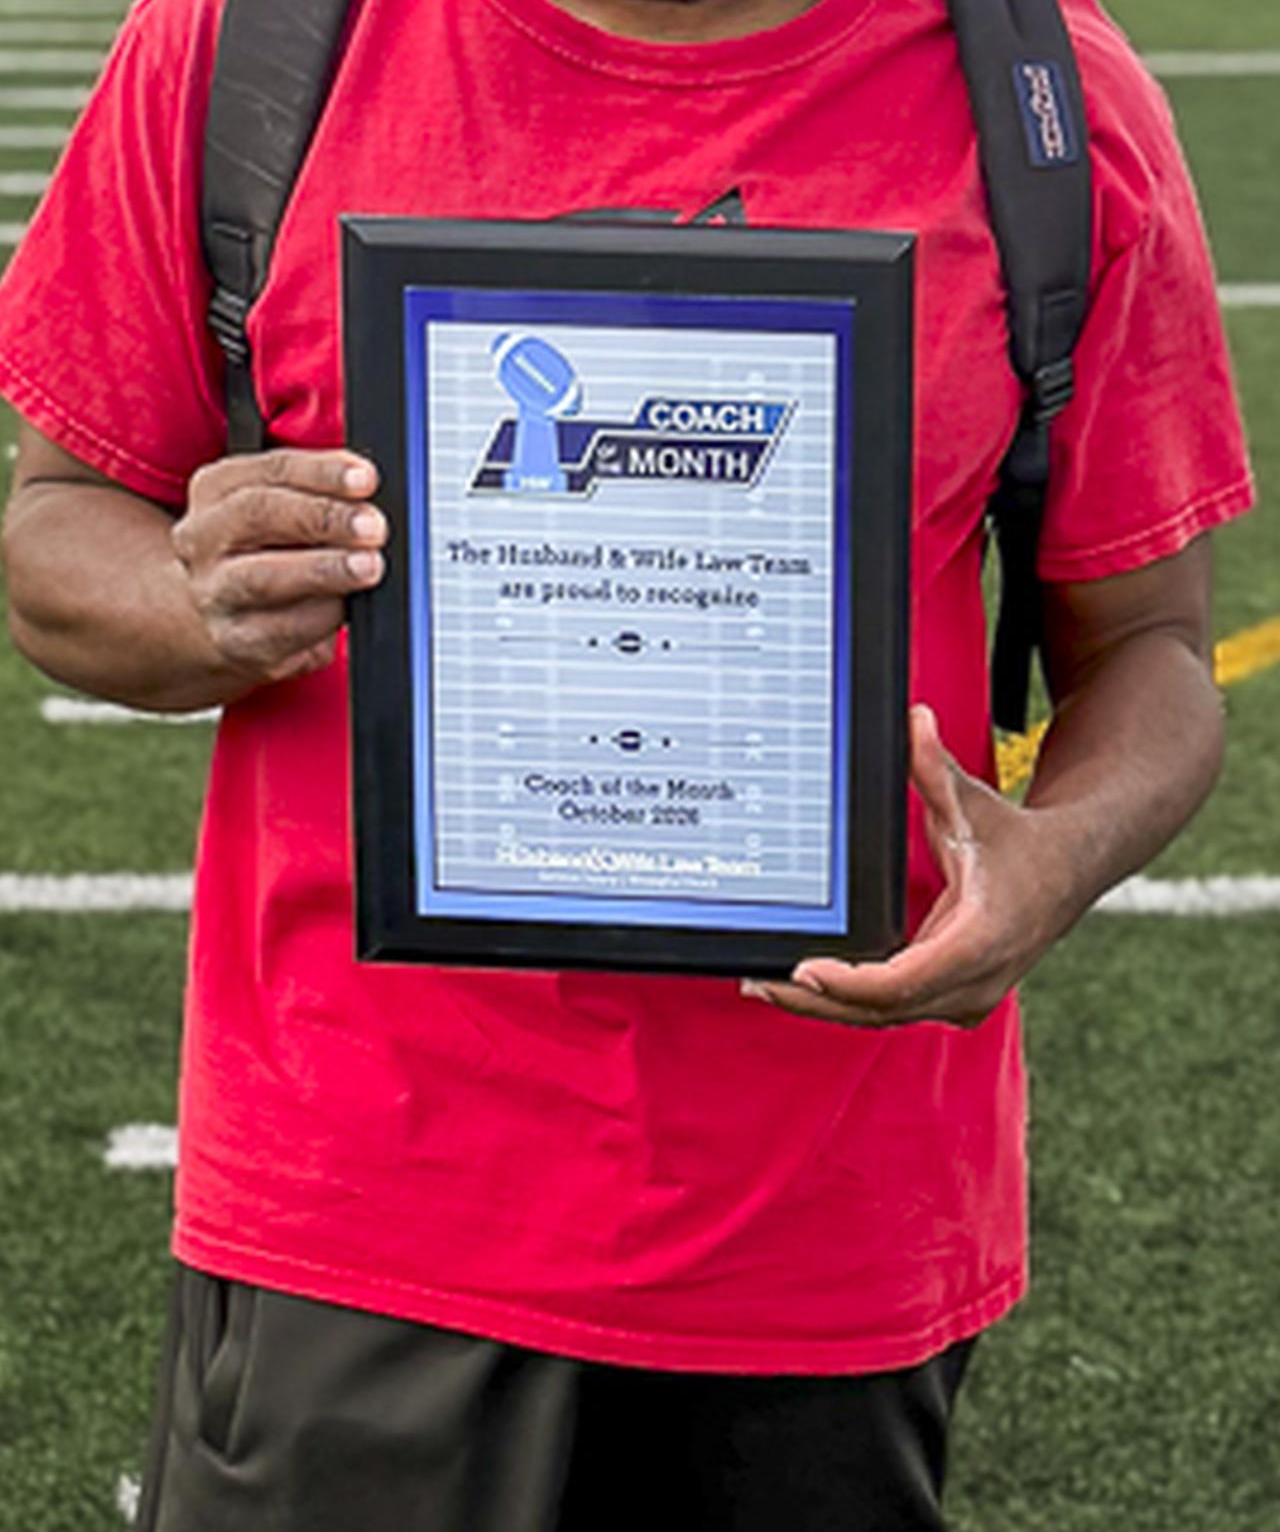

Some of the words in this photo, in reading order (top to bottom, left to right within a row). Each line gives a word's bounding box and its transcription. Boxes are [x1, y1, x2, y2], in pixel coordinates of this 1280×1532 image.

[648, 403, 765, 432] COACH
[629, 447, 748, 479] MONTH
[448, 541, 492, 565] The
[498, 543, 603, 569] Husband
[609, 549, 627, 569] &
[630, 549, 687, 571] Wife
[695, 551, 743, 571] Law
[746, 553, 811, 575] Team
[500, 581, 535, 599] are
[542, 579, 611, 604] proud
[616, 584, 641, 604] to
[524, 774, 592, 795] Coach
[601, 776, 622, 795] of
[626, 779, 660, 796] the
[667, 778, 734, 799] Month
[558, 799, 645, 823] October
